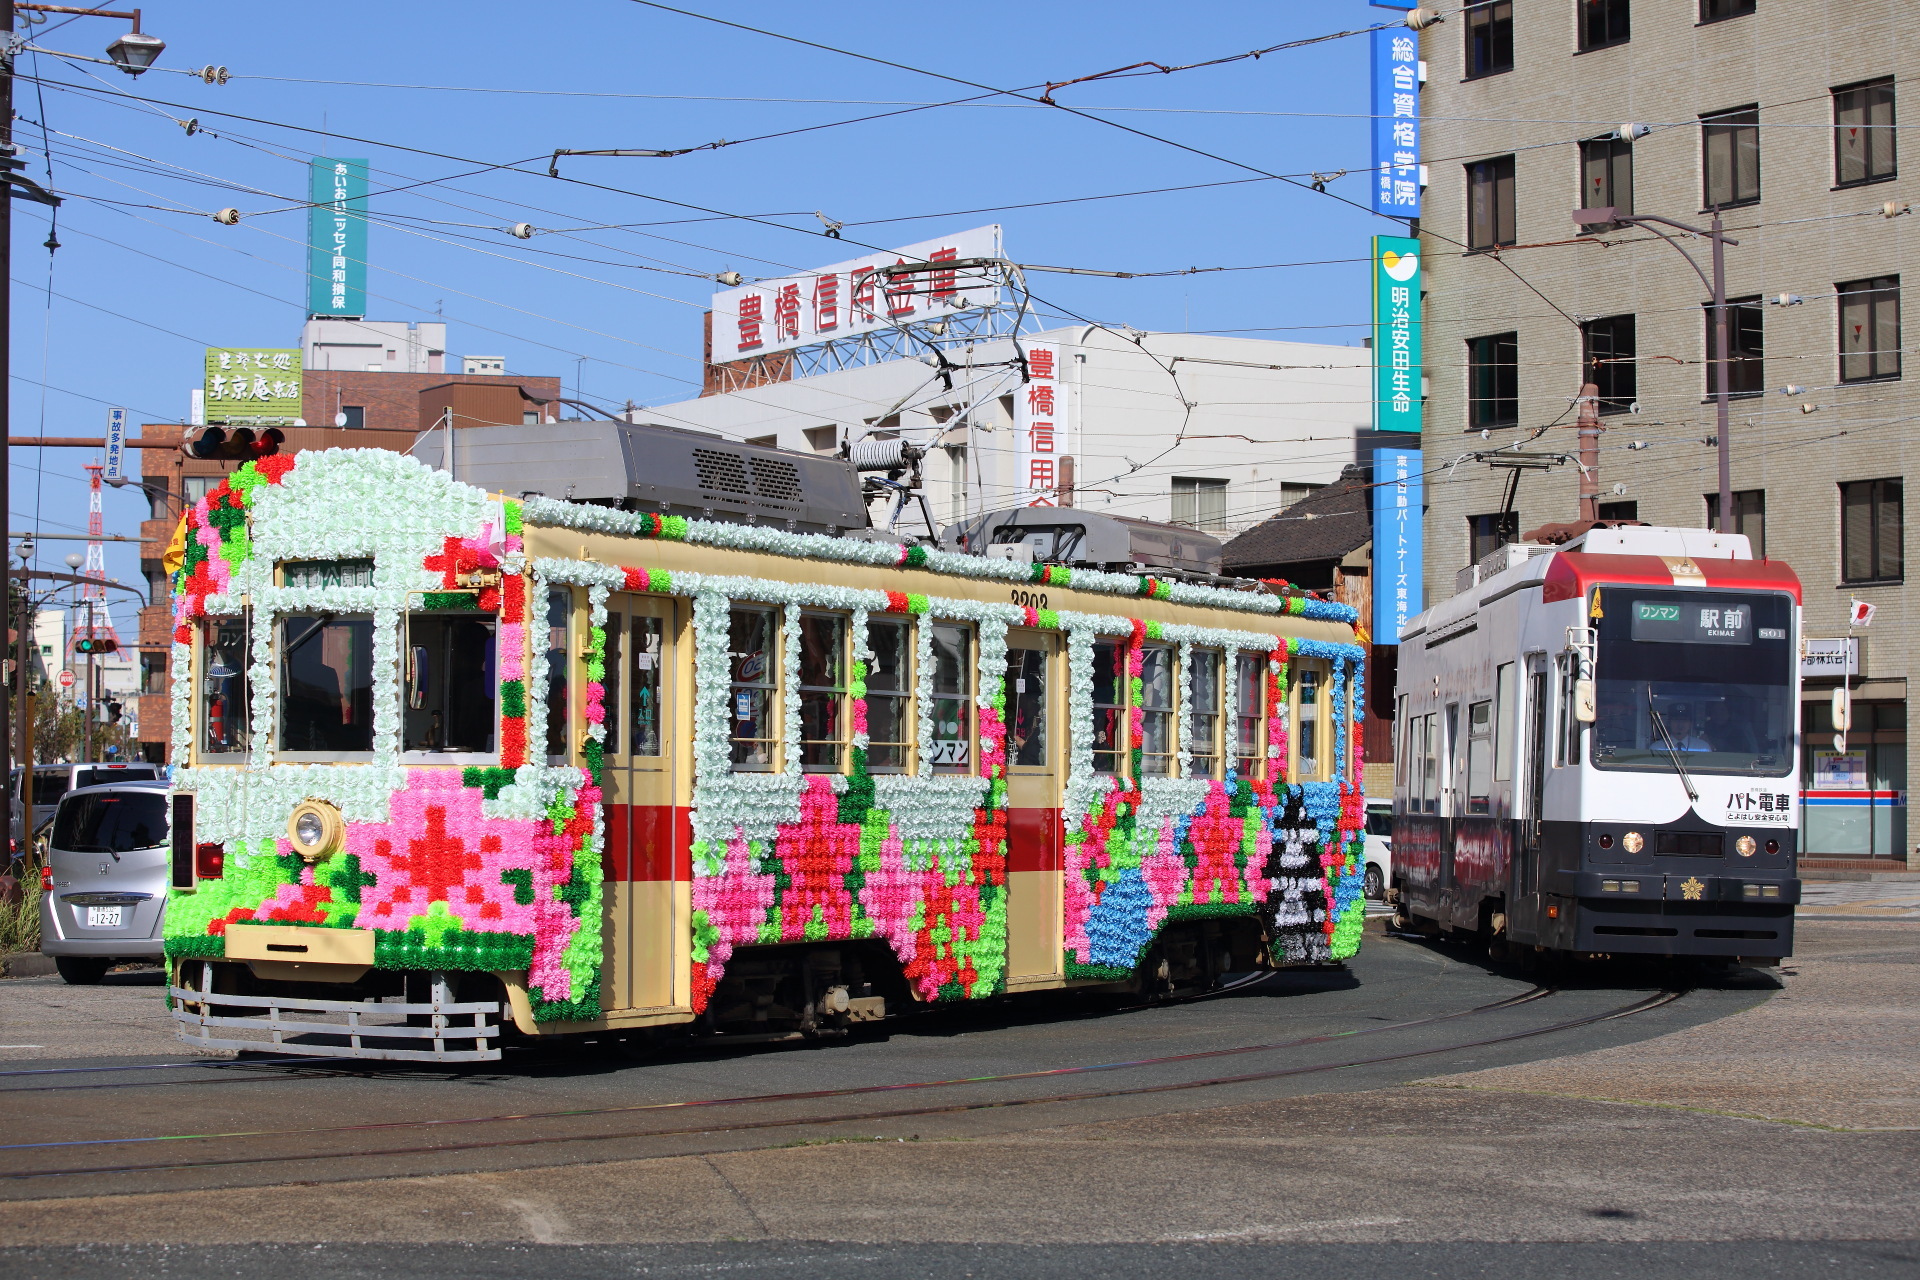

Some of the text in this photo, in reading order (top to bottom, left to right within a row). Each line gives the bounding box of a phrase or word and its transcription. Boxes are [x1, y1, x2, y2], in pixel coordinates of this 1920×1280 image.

[1392, 36, 1416, 206] 総合資格学院
[1380, 161, 1391, 205] 豊橋校
[331, 163, 347, 309] あいおいニッセイ同和損保
[737, 246, 957, 349] 豊橋信用金庫
[1391, 286, 1410, 413] 明治安田生命
[107, 410, 123, 477] 事故多発地点
[291, 564, 371, 588] 運動公園前
[1641, 606, 1678, 619] ワンマン
[1700, 609, 1743, 629] 駅前
[1707, 629, 1735, 637] EKIMAE
[1760, 630, 1782, 638] 801
[932, 742, 968, 762] ンマン
[1727, 792, 1790, 812] パト電車
[1727, 813, 1788, 822] とよはし安全安心号
[96, 913, 119, 924] 12-27
